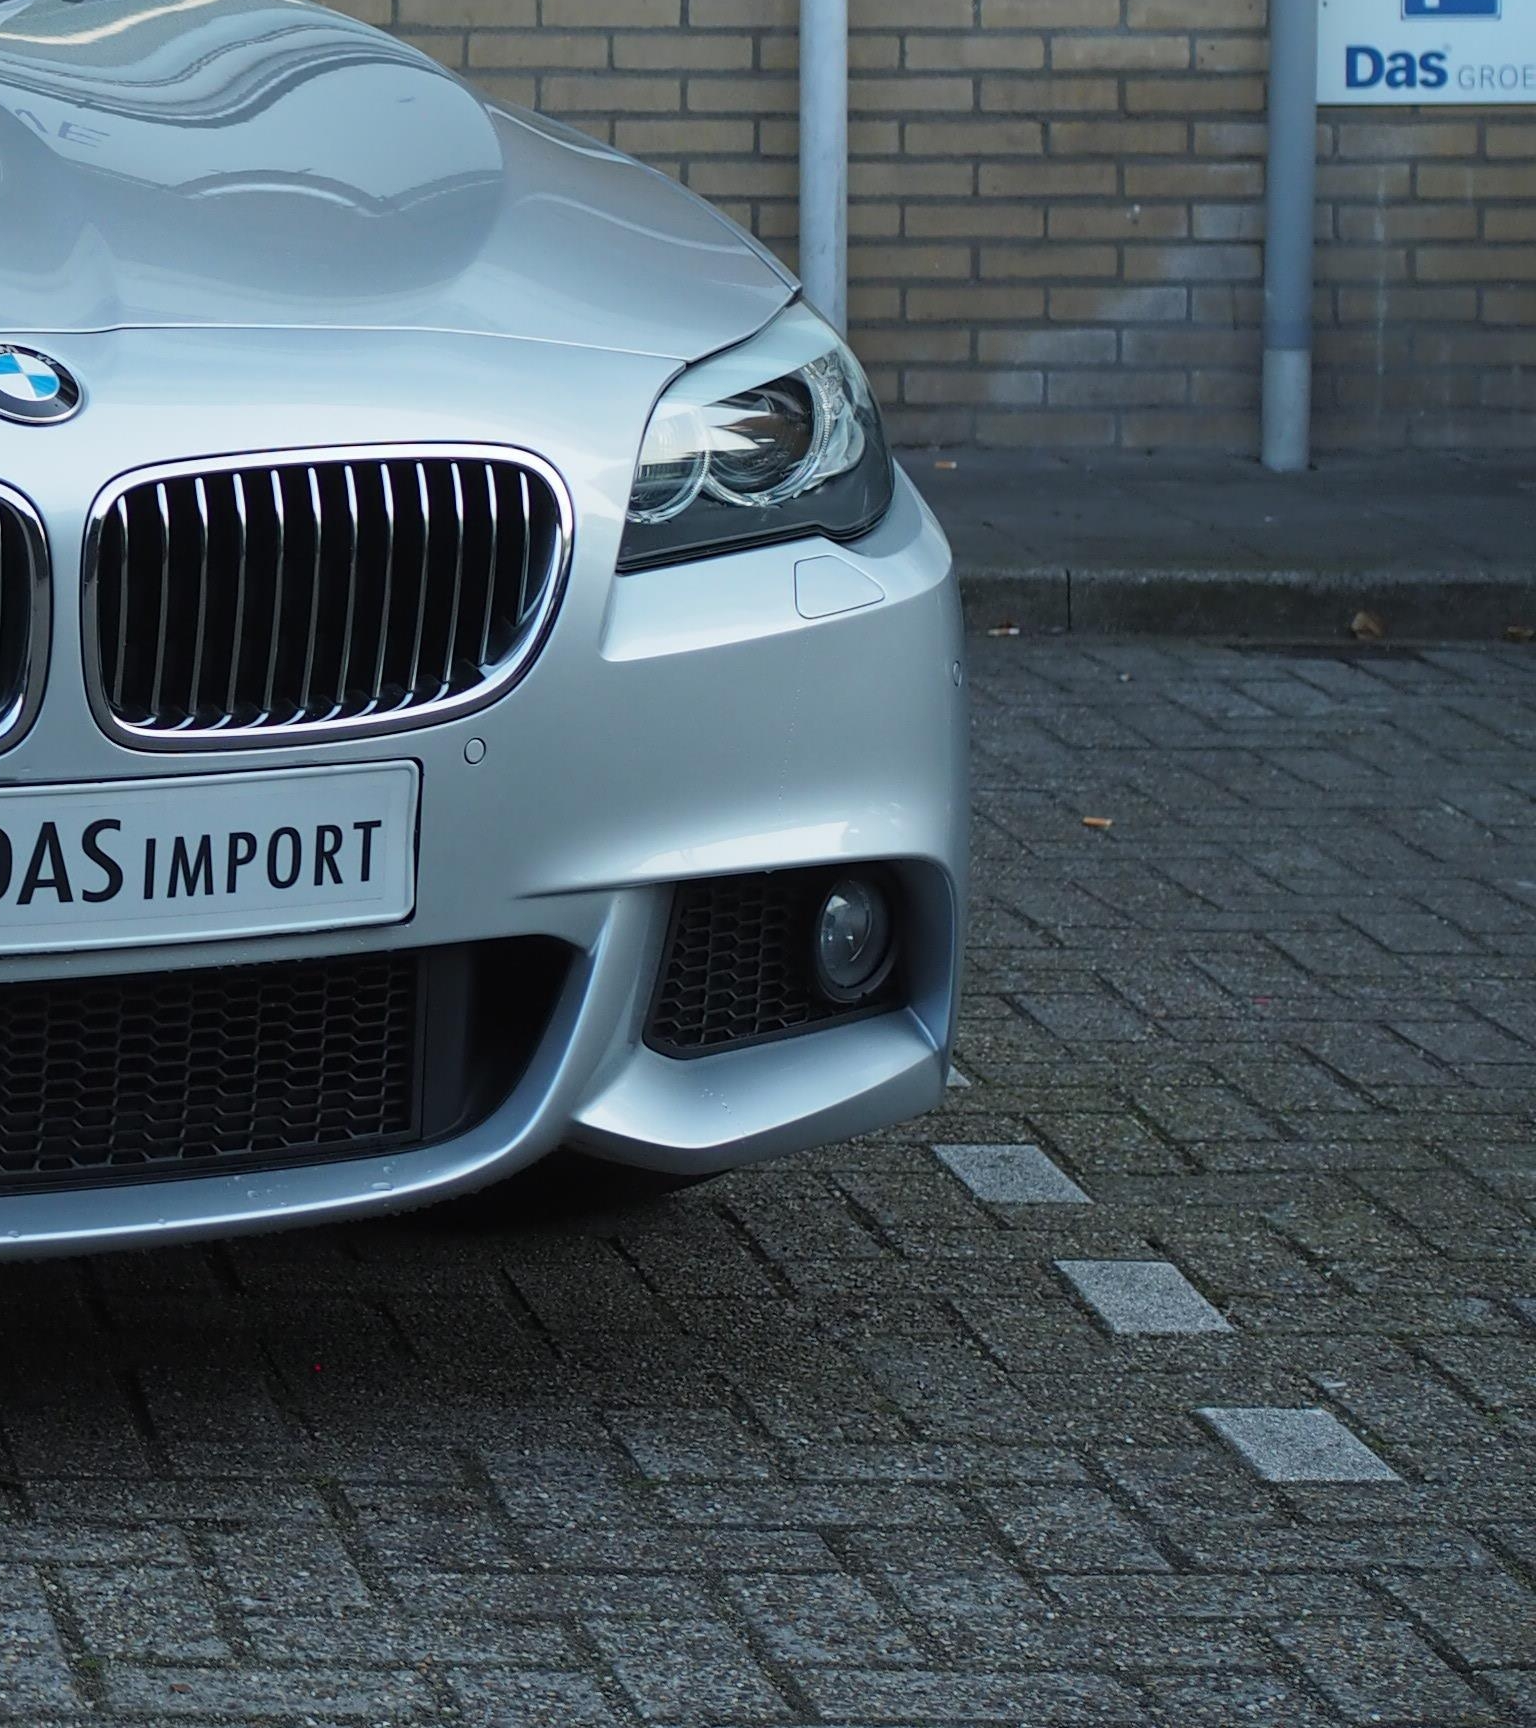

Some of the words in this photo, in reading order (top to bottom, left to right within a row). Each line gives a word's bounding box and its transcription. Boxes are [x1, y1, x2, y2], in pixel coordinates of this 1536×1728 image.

[1345, 45, 1448, 89] Das
[1458, 65, 1536, 90] GROE
[143, 819, 383, 900] IMPORT
